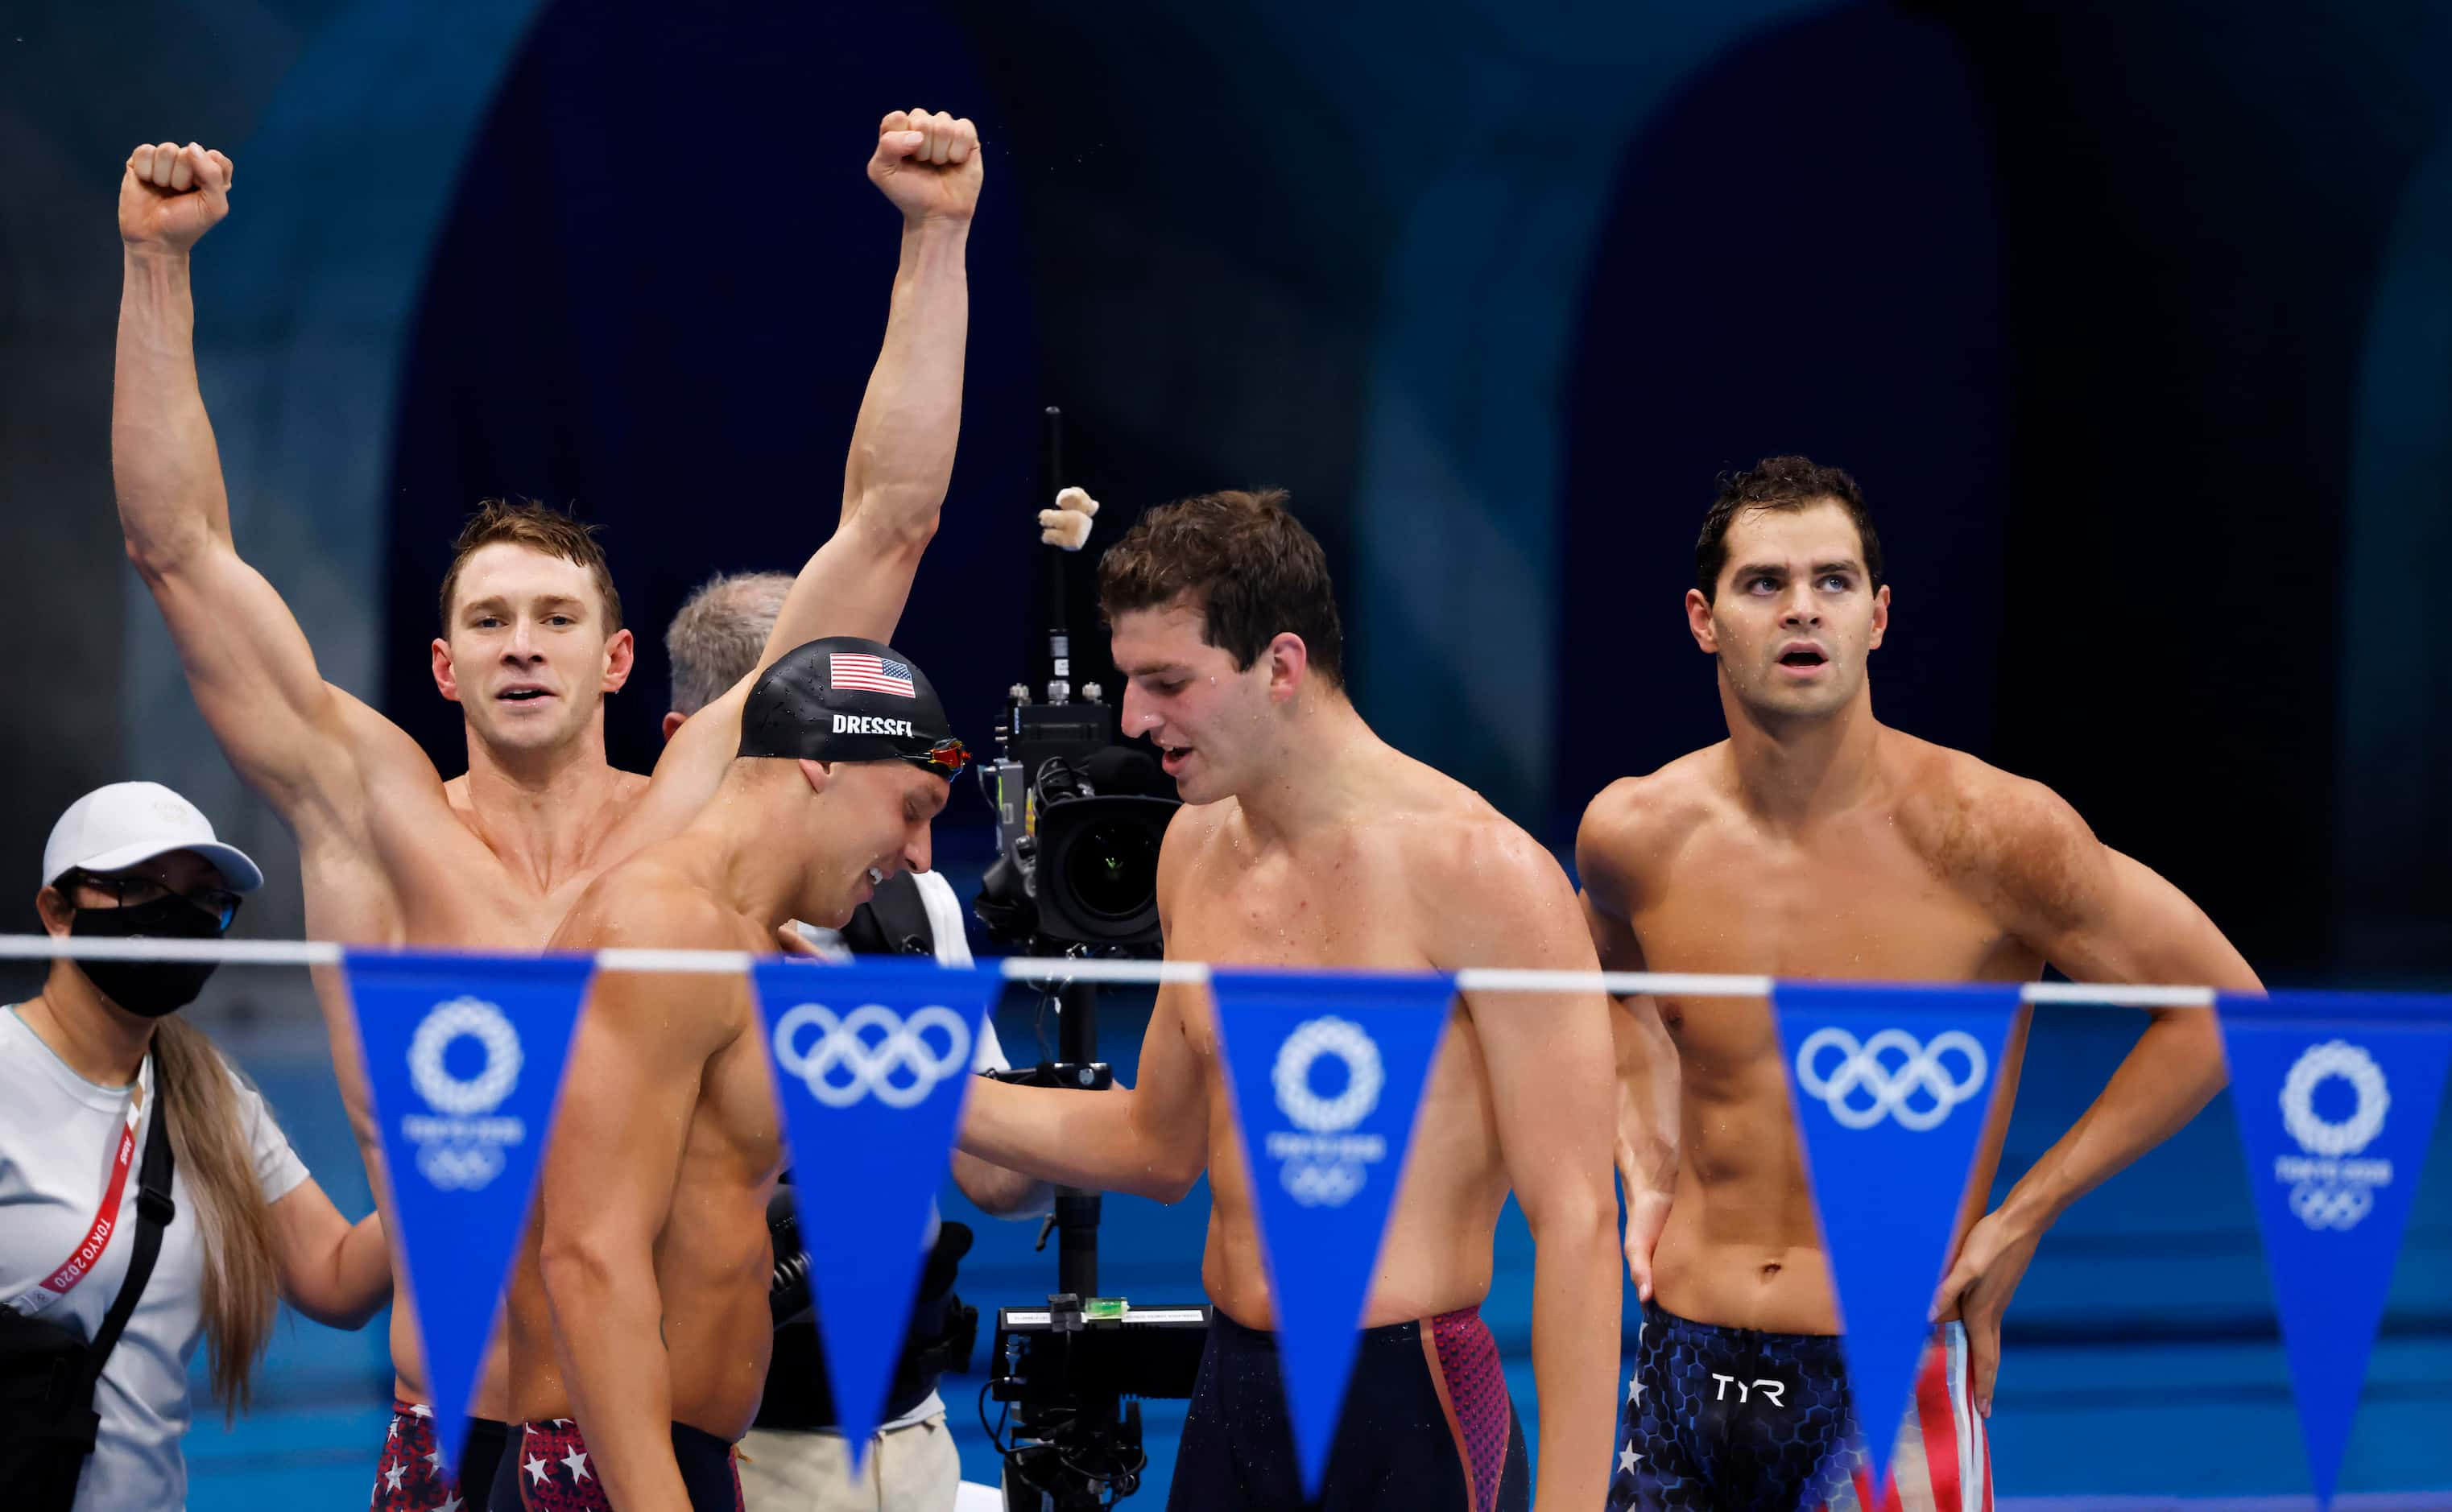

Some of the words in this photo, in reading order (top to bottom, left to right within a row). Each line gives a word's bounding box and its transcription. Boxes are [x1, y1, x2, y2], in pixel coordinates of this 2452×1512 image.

[833, 714, 914, 738] DRESSEL
[82, 1218, 110, 1260] TOKYO
[54, 1257, 86, 1287] 2020
[1712, 1373, 1784, 1407] TYR
